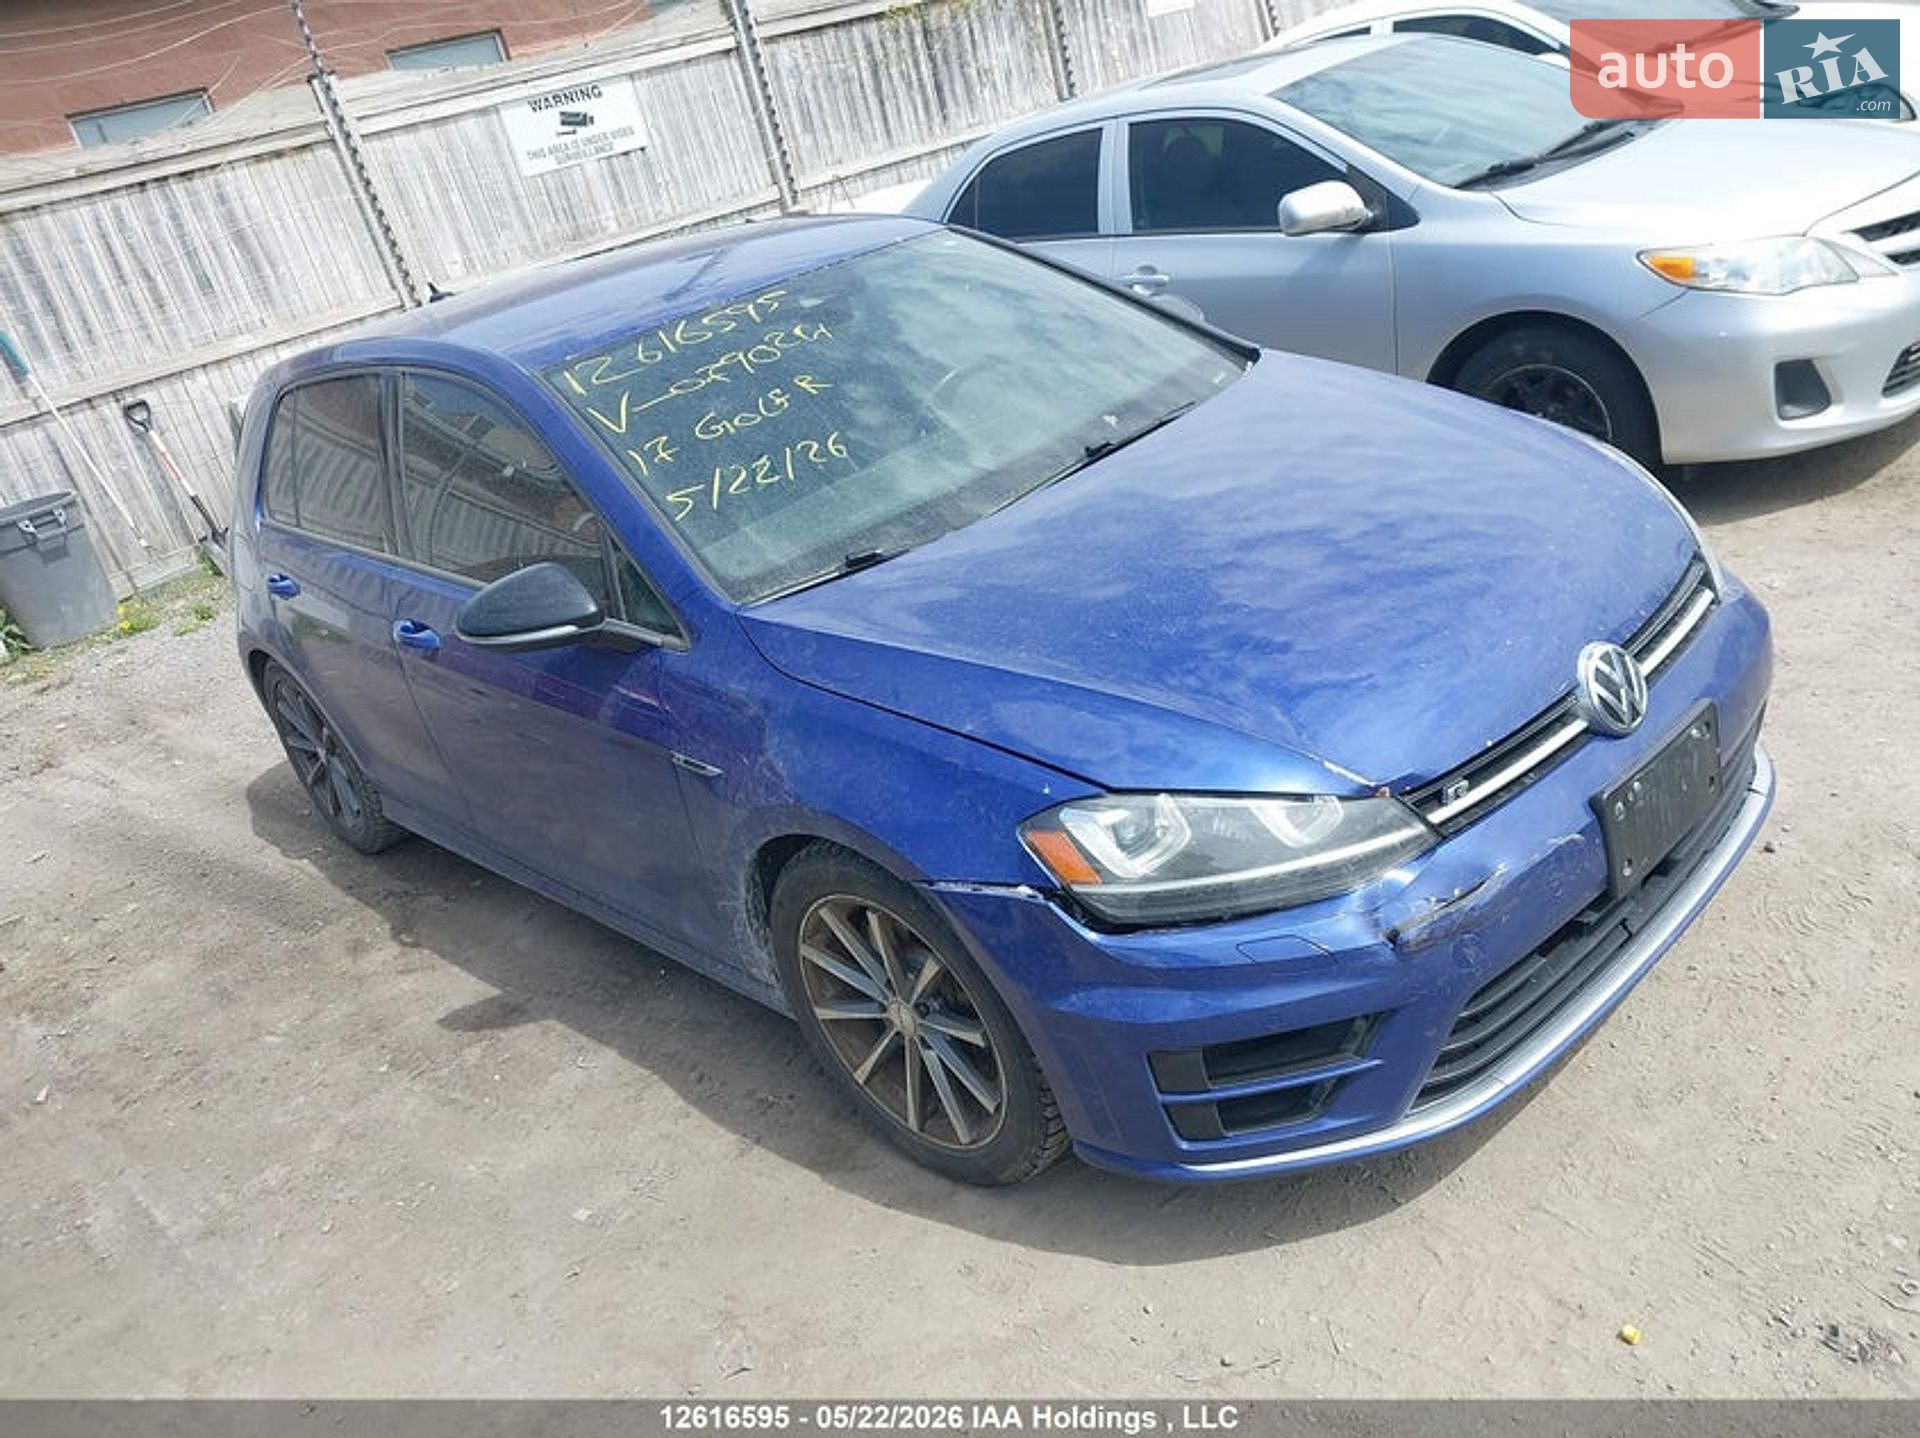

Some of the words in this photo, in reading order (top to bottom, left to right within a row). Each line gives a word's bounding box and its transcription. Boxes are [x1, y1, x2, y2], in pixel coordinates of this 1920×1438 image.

[527, 84, 604, 112] WARNING
[627, 436, 681, 476] 17
[792, 375, 834, 395] R
[666, 431, 848, 521] 5/22/26
